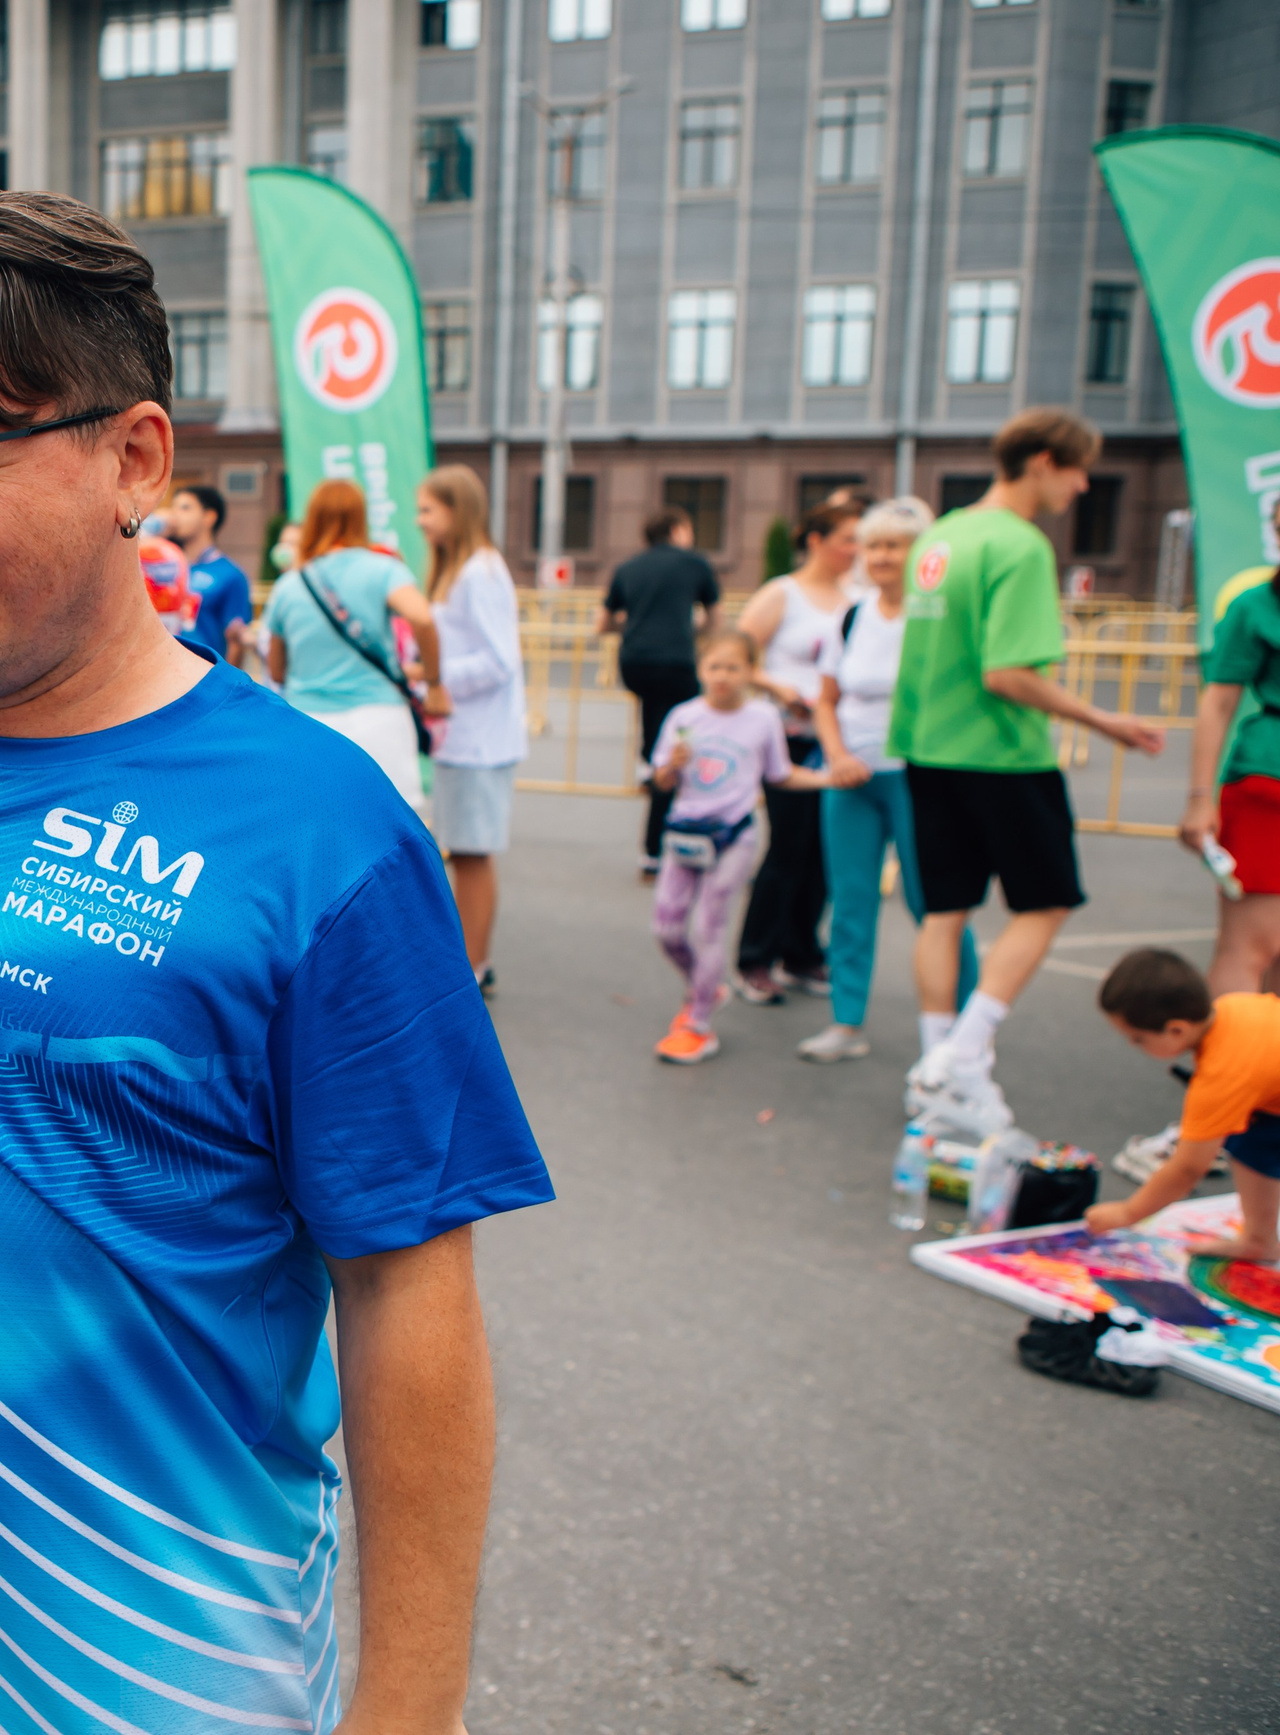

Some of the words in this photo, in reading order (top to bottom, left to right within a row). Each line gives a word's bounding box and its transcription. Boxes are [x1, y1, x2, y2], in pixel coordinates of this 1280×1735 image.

[12, 877, 173, 942] МЕЖДУНАРОДНЫЙ
[21, 857, 183, 925] СИБИРСКИЙ
[1, 891, 165, 967] МАРАФОН
